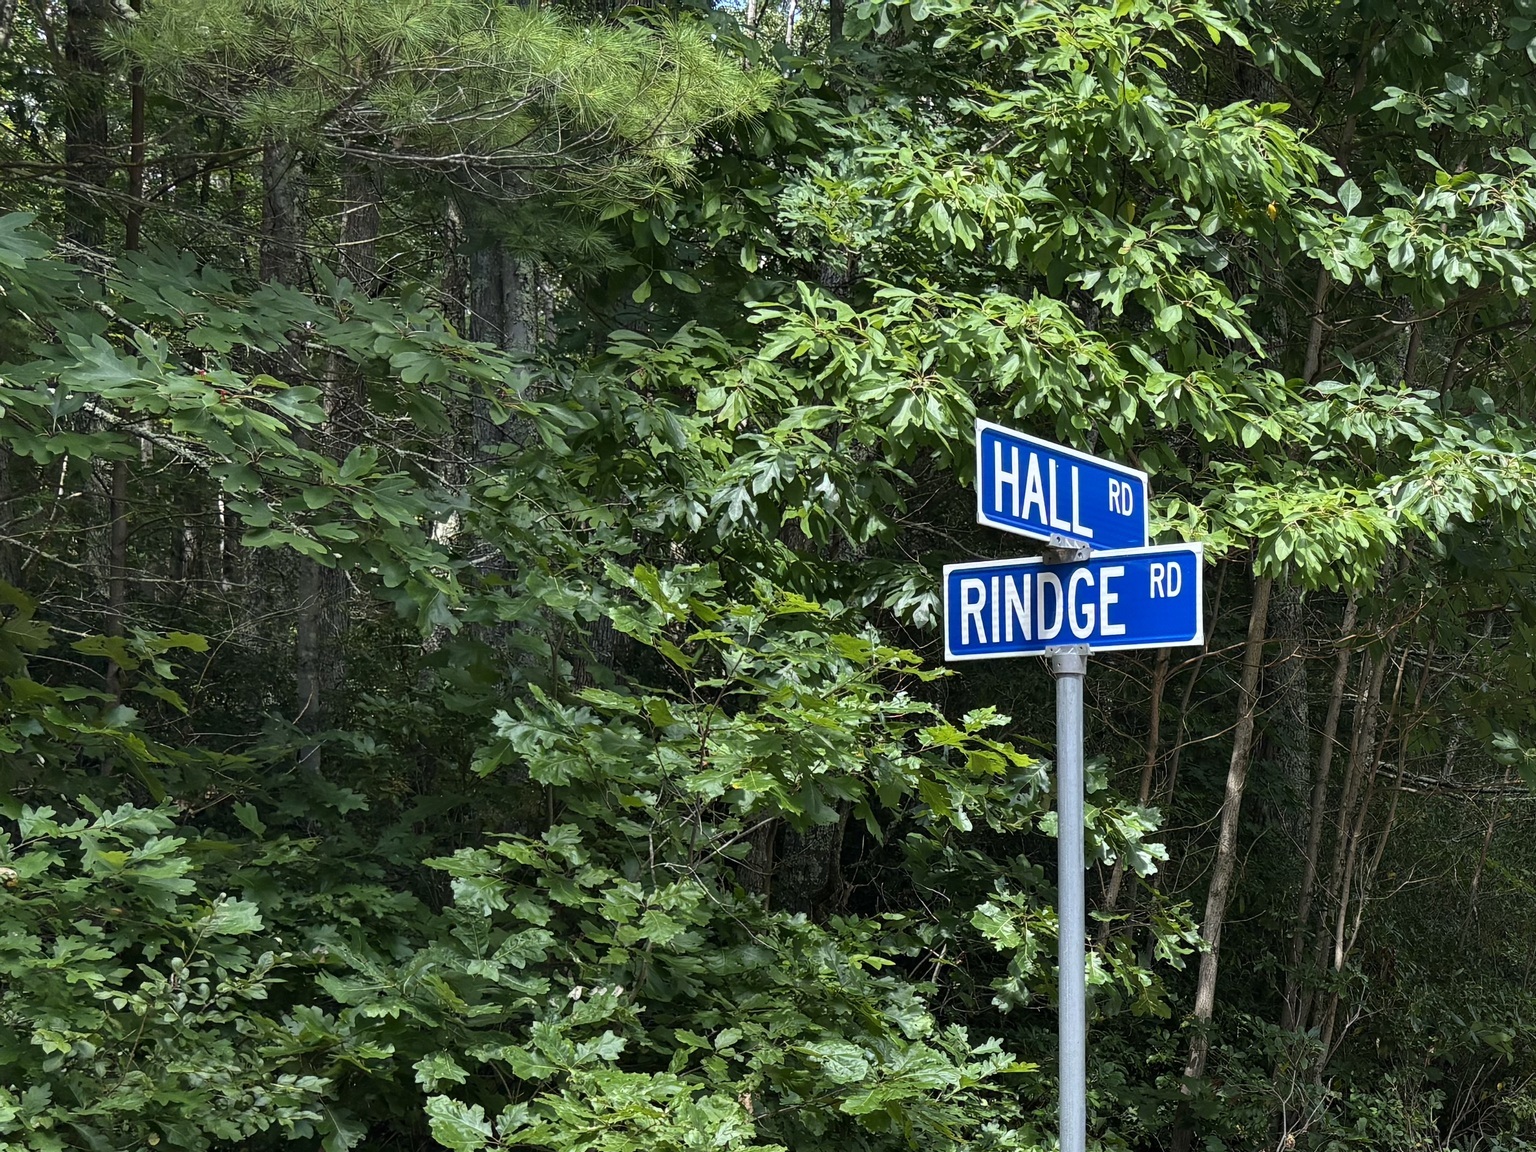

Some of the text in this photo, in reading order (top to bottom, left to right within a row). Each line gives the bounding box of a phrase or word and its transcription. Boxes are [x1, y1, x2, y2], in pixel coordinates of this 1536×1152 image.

[994, 440, 1134, 539] HALL RD
[960, 561, 1182, 645] RINDGE RD
